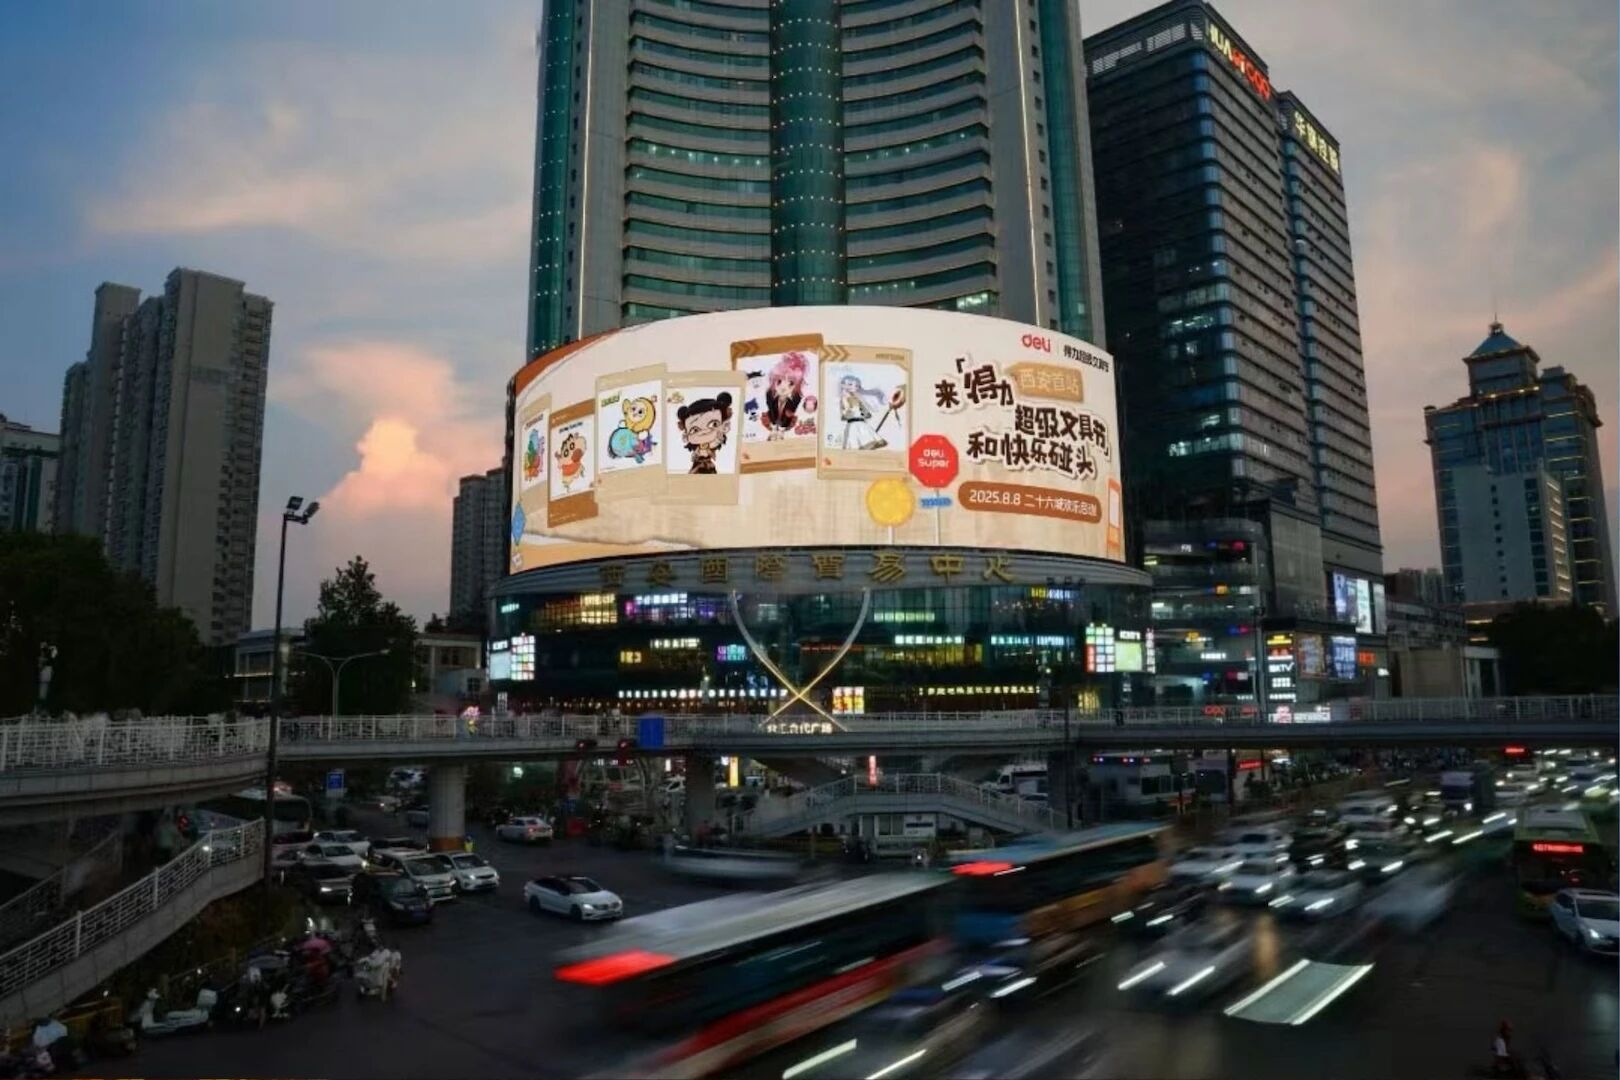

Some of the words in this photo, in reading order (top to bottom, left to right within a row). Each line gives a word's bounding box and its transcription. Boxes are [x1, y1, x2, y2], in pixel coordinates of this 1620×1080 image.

[1022, 334, 1051, 353] deli
[966, 431, 1094, 474] 和快乐碰头
[968, 489, 1021, 506] 2025.8.8
